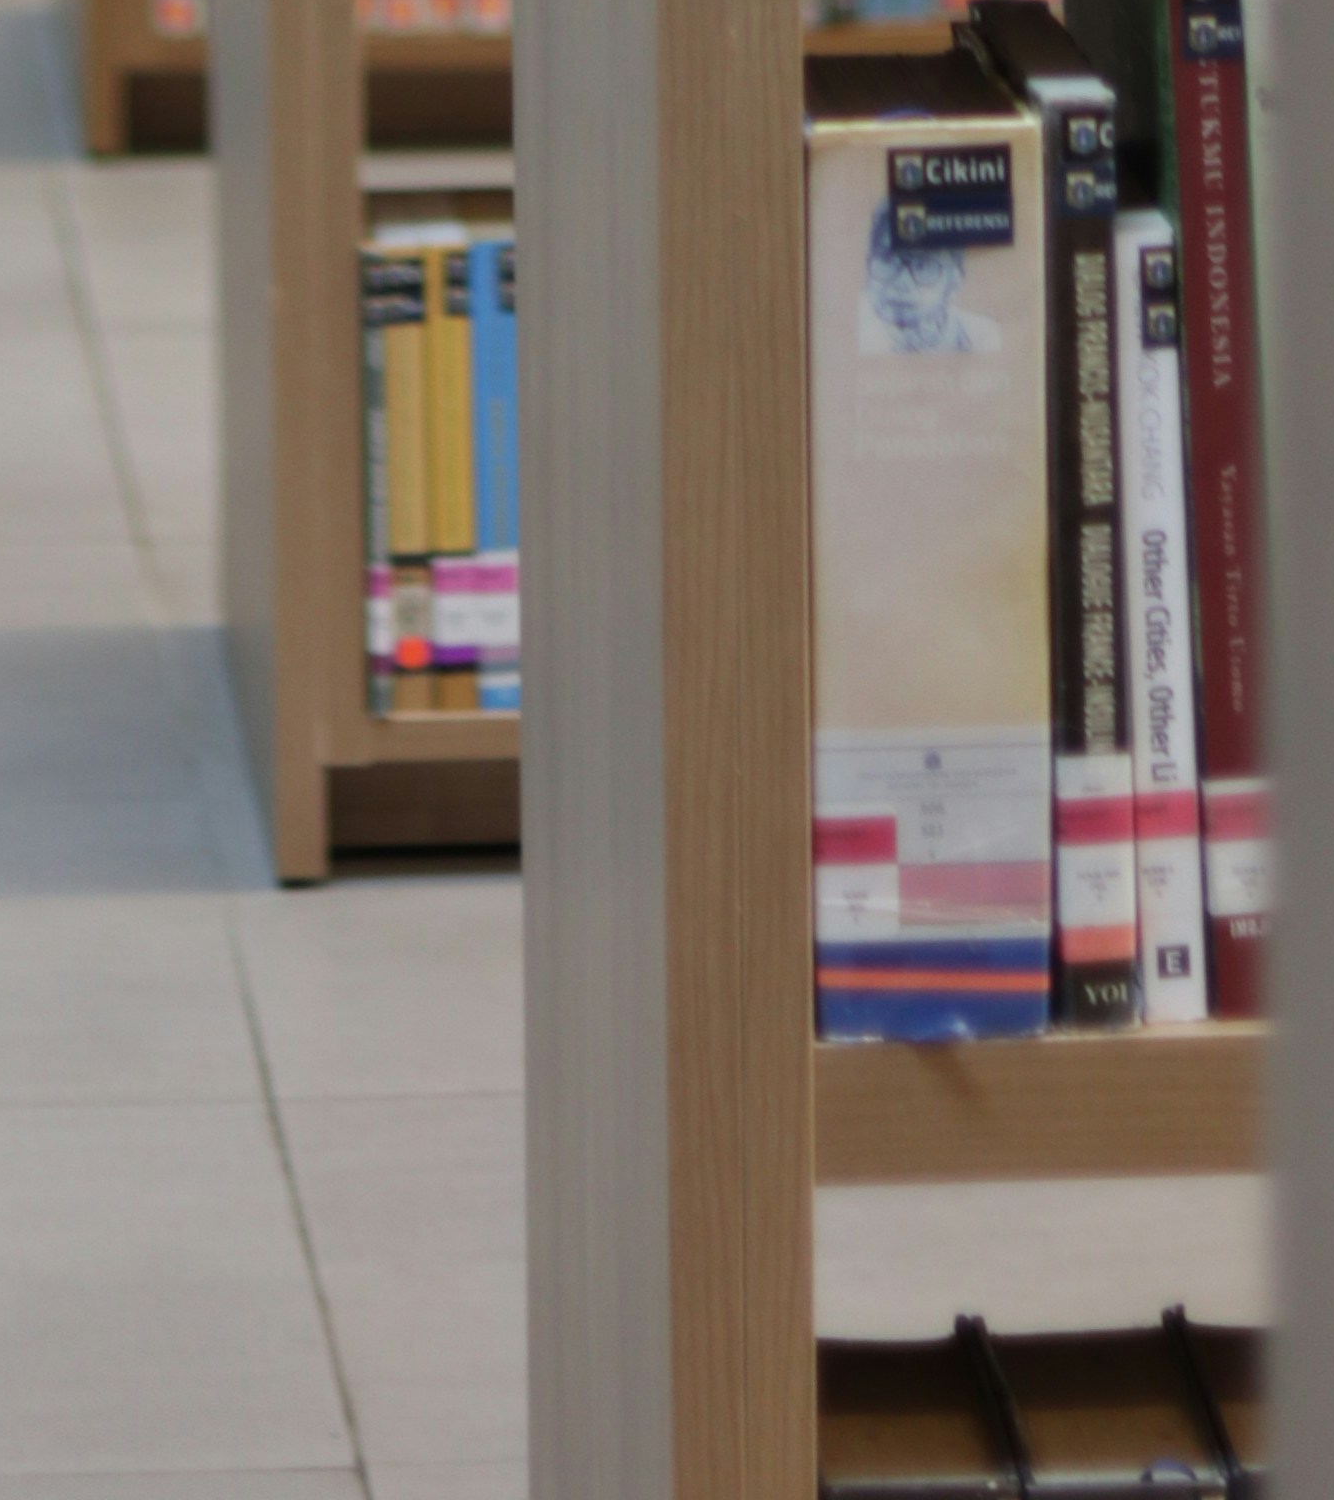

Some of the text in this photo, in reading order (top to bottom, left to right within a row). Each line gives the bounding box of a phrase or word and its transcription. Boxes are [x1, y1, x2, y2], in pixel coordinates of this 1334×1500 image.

[925, 155, 1006, 186] Cikini
[926, 212, 1010, 232] REFERENSI
[1204, 203, 1232, 389] INDONESIA
[1142, 528, 1169, 600] Other
[1143, 605, 1172, 680] Cities,
[1148, 685, 1175, 757] Other
